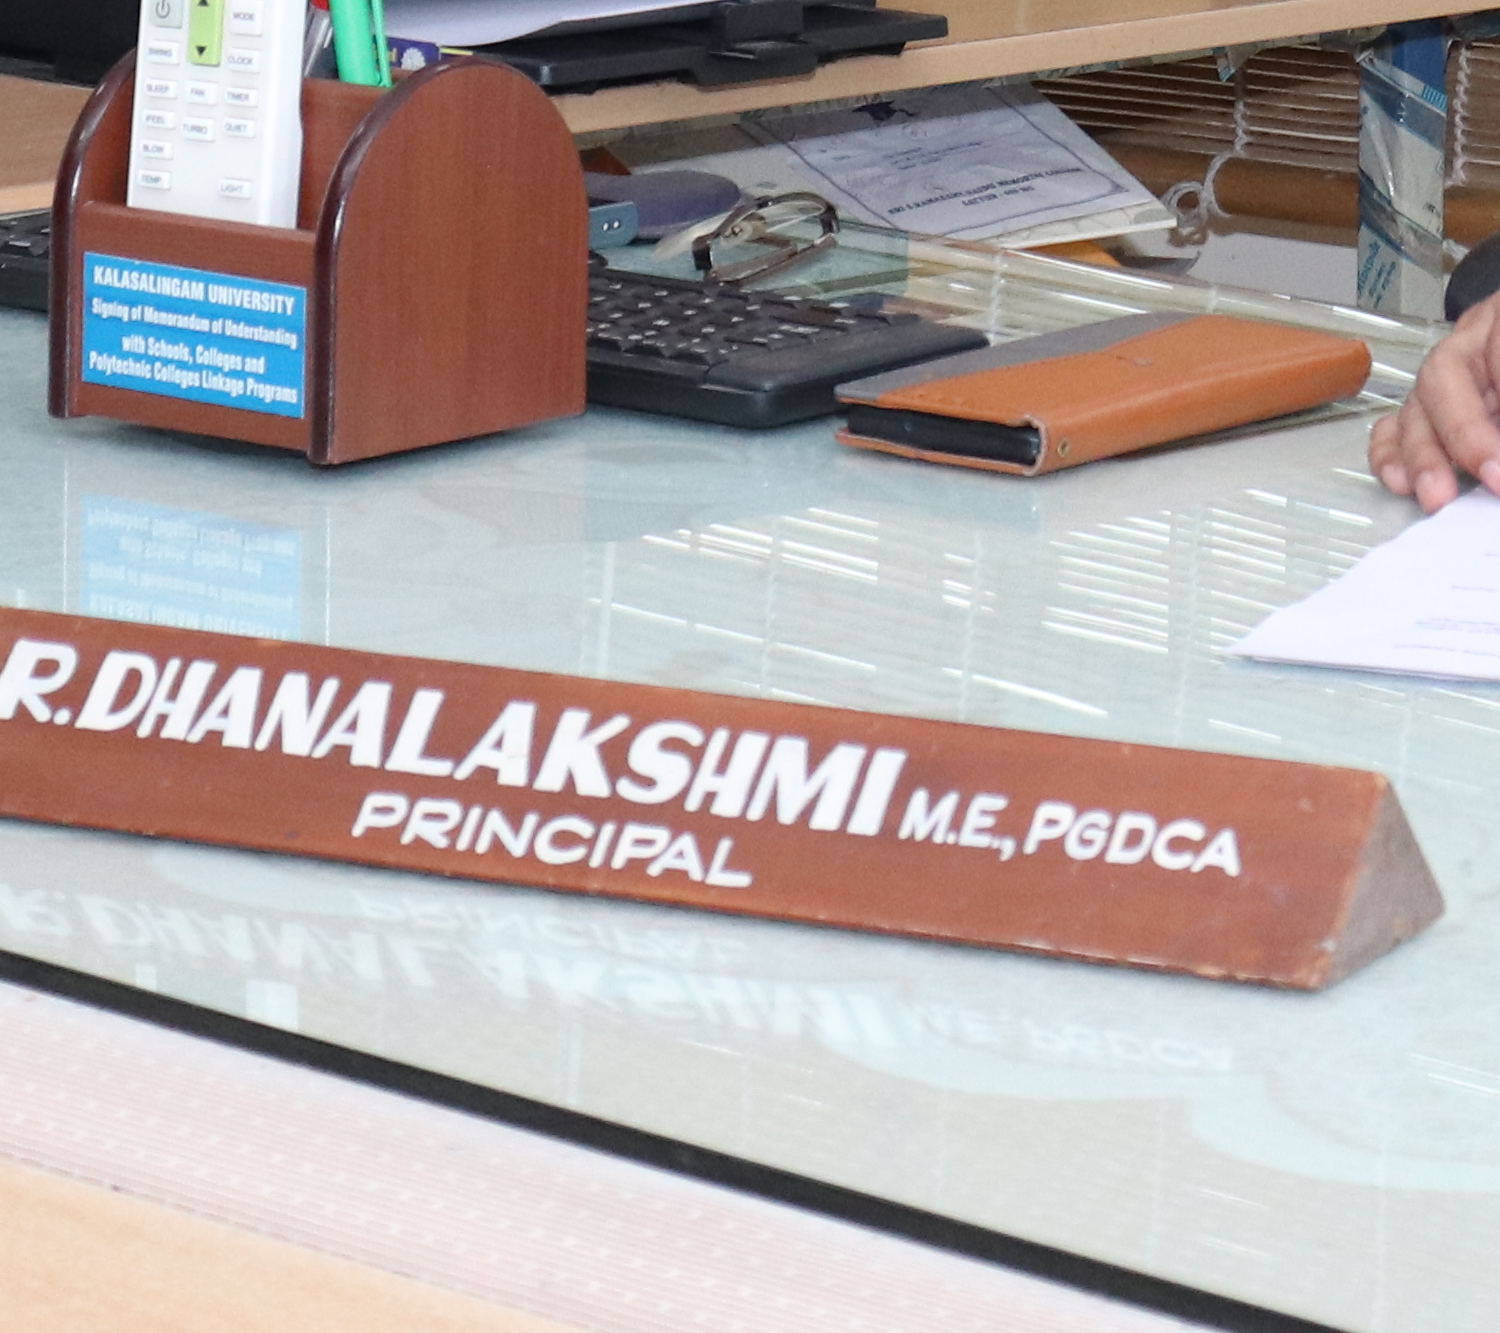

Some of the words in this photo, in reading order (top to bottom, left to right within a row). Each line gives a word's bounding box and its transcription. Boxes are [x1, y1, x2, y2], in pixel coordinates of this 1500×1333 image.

[93, 265, 206, 301] KALASALINGAM
[208, 283, 295, 316] UNIVERSITY
[91, 297, 130, 322] Signing
[131, 305, 143, 321] of
[144, 307, 210, 332] Memorandum
[211, 317, 223, 335] of
[224, 319, 299, 351] Understanding
[88, 350, 152, 377] Polytechnic
[154, 361, 200, 389] Colleges
[202, 370, 244, 398] Linkage
[246, 378, 299, 404] Programs
[121, 334, 146, 354] with
[147, 337, 193, 364] Schools,
[195, 344, 242, 372] Colleges
[244, 355, 266, 375] and
[350, 791, 755, 890] PRINCIPAL
[1021, 798, 1242, 878] PGDCA
